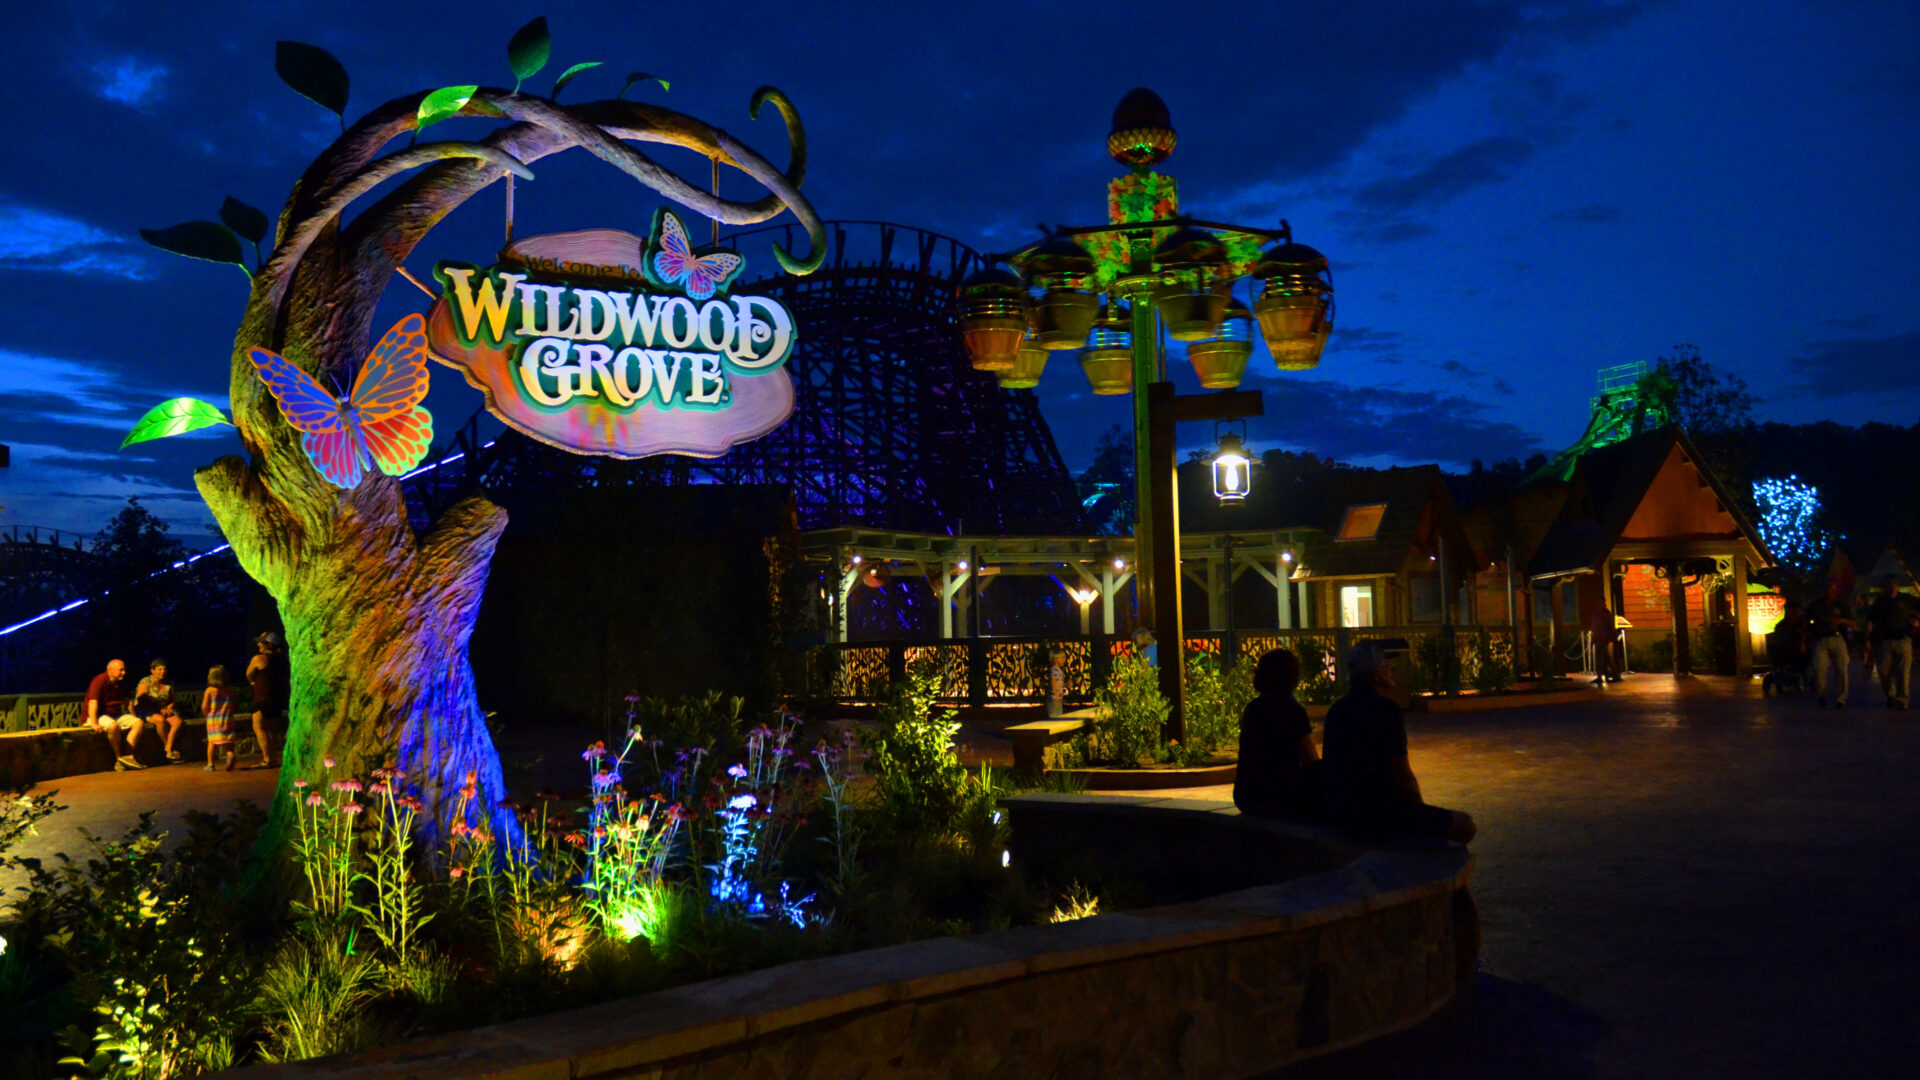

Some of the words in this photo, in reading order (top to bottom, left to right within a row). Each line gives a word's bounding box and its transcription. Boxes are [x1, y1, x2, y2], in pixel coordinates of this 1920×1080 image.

[524, 254, 613, 276] Welcome
[444, 267, 793, 368] WILDWOOD
[519, 339, 722, 405] GROVE
